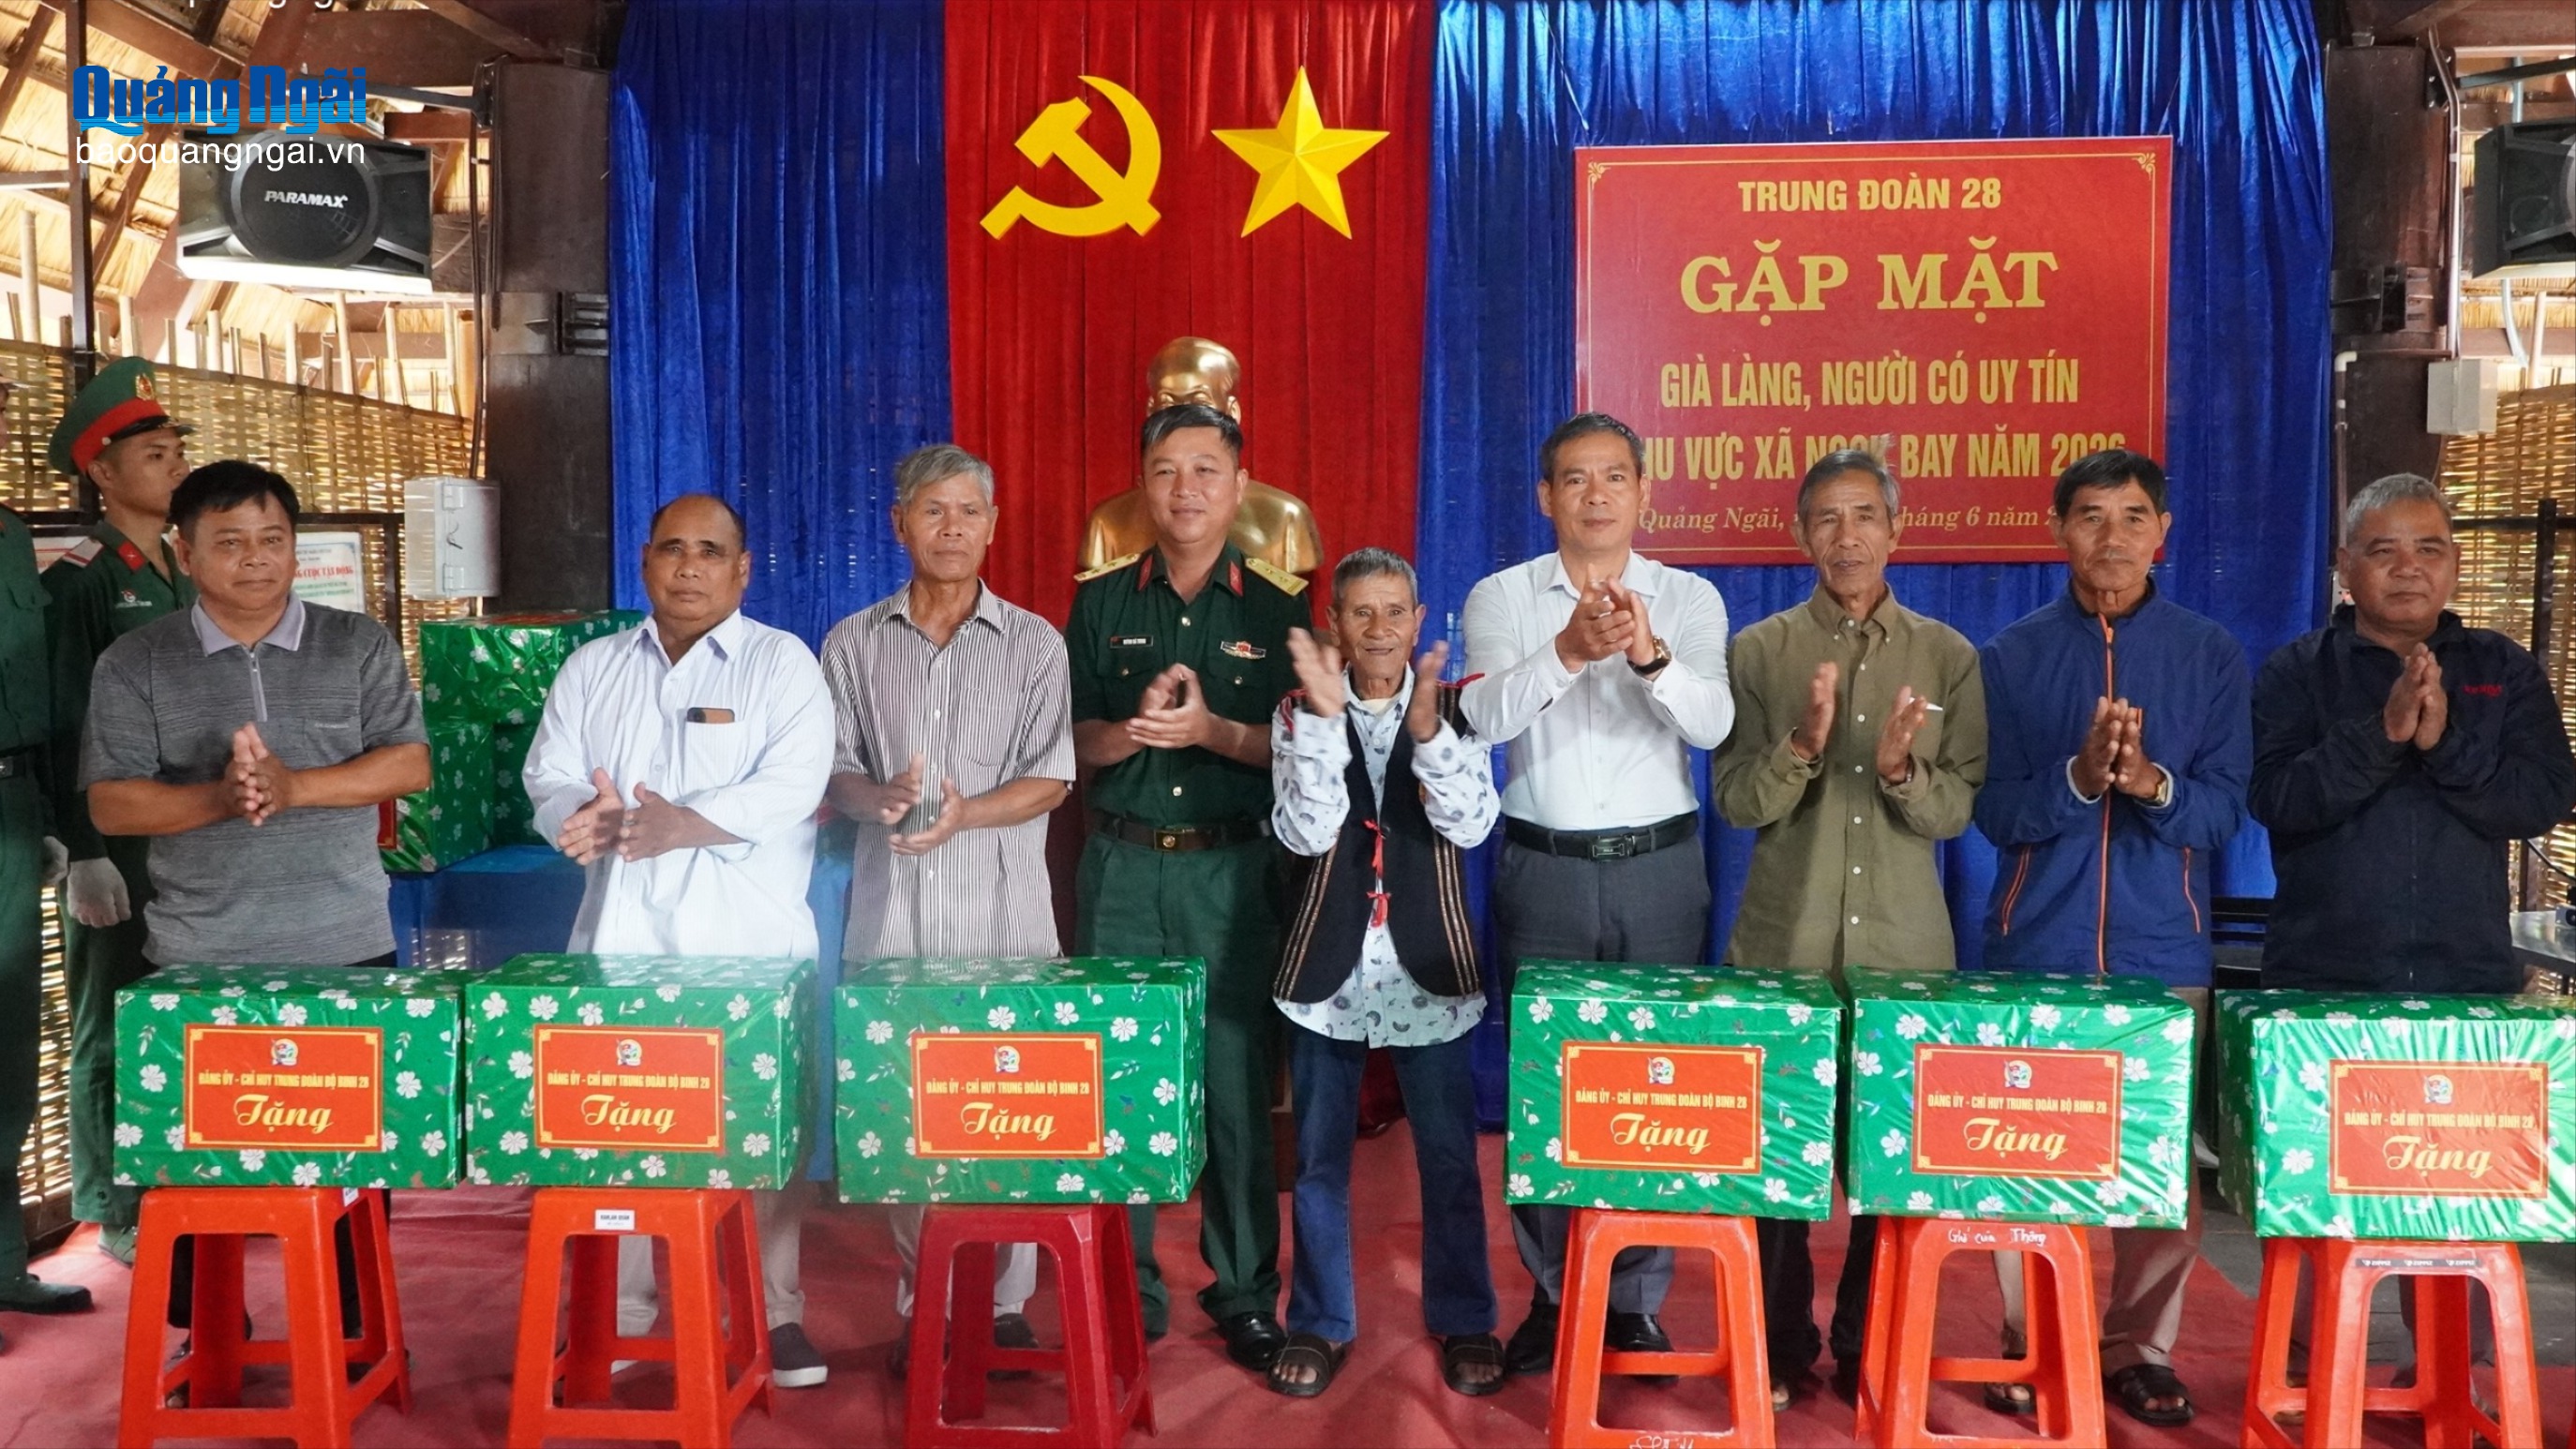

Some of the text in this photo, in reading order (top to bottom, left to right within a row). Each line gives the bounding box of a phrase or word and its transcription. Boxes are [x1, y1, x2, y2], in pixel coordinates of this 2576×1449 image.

[264, 190, 348, 208] PARAMAX
[1739, 172, 2001, 213] TRUNG ĐOÀN 28
[1681, 234, 2058, 327] GẶP MẶT
[1661, 350, 2078, 412] GIÀ LÀNG, NGƯỜI CÓ UY TÍN
[1641, 437, 1674, 481] HU
[1685, 431, 1744, 490] VỰC
[1754, 426, 1795, 480] XÃ
[1900, 434, 1958, 478] BAY
[1969, 424, 2040, 477] NĂM
[1640, 505, 1717, 533] Quảng
[1723, 506, 1784, 532] Ngãi,
[1901, 506, 1960, 530] háng
[1966, 506, 1981, 527] 6
[1986, 507, 2038, 526] năm
[234, 1094, 334, 1134] Tặng
[581, 1094, 677, 1134] Tặng
[1617, 1088, 1631, 1104] CHỈ
[1632, 1092, 1648, 1105] HUY
[1650, 1093, 1676, 1106] TRUNG
[1678, 1092, 1700, 1107] ĐOÀN
[1702, 1093, 1713, 1110] BỘ
[1971, 1093, 1985, 1109] CHỈ
[1987, 1097, 2004, 1110] HUY
[2006, 1097, 2033, 1111] TRUNG
[2035, 1097, 2059, 1112] ĐOÀN
[2059, 1097, 2073, 1114] BỘ
[960, 1101, 1056, 1142] Tặng
[1610, 1113, 1711, 1155] Tặng
[1963, 1117, 2068, 1161] Tặng
[2383, 1135, 2494, 1179] Tặng
